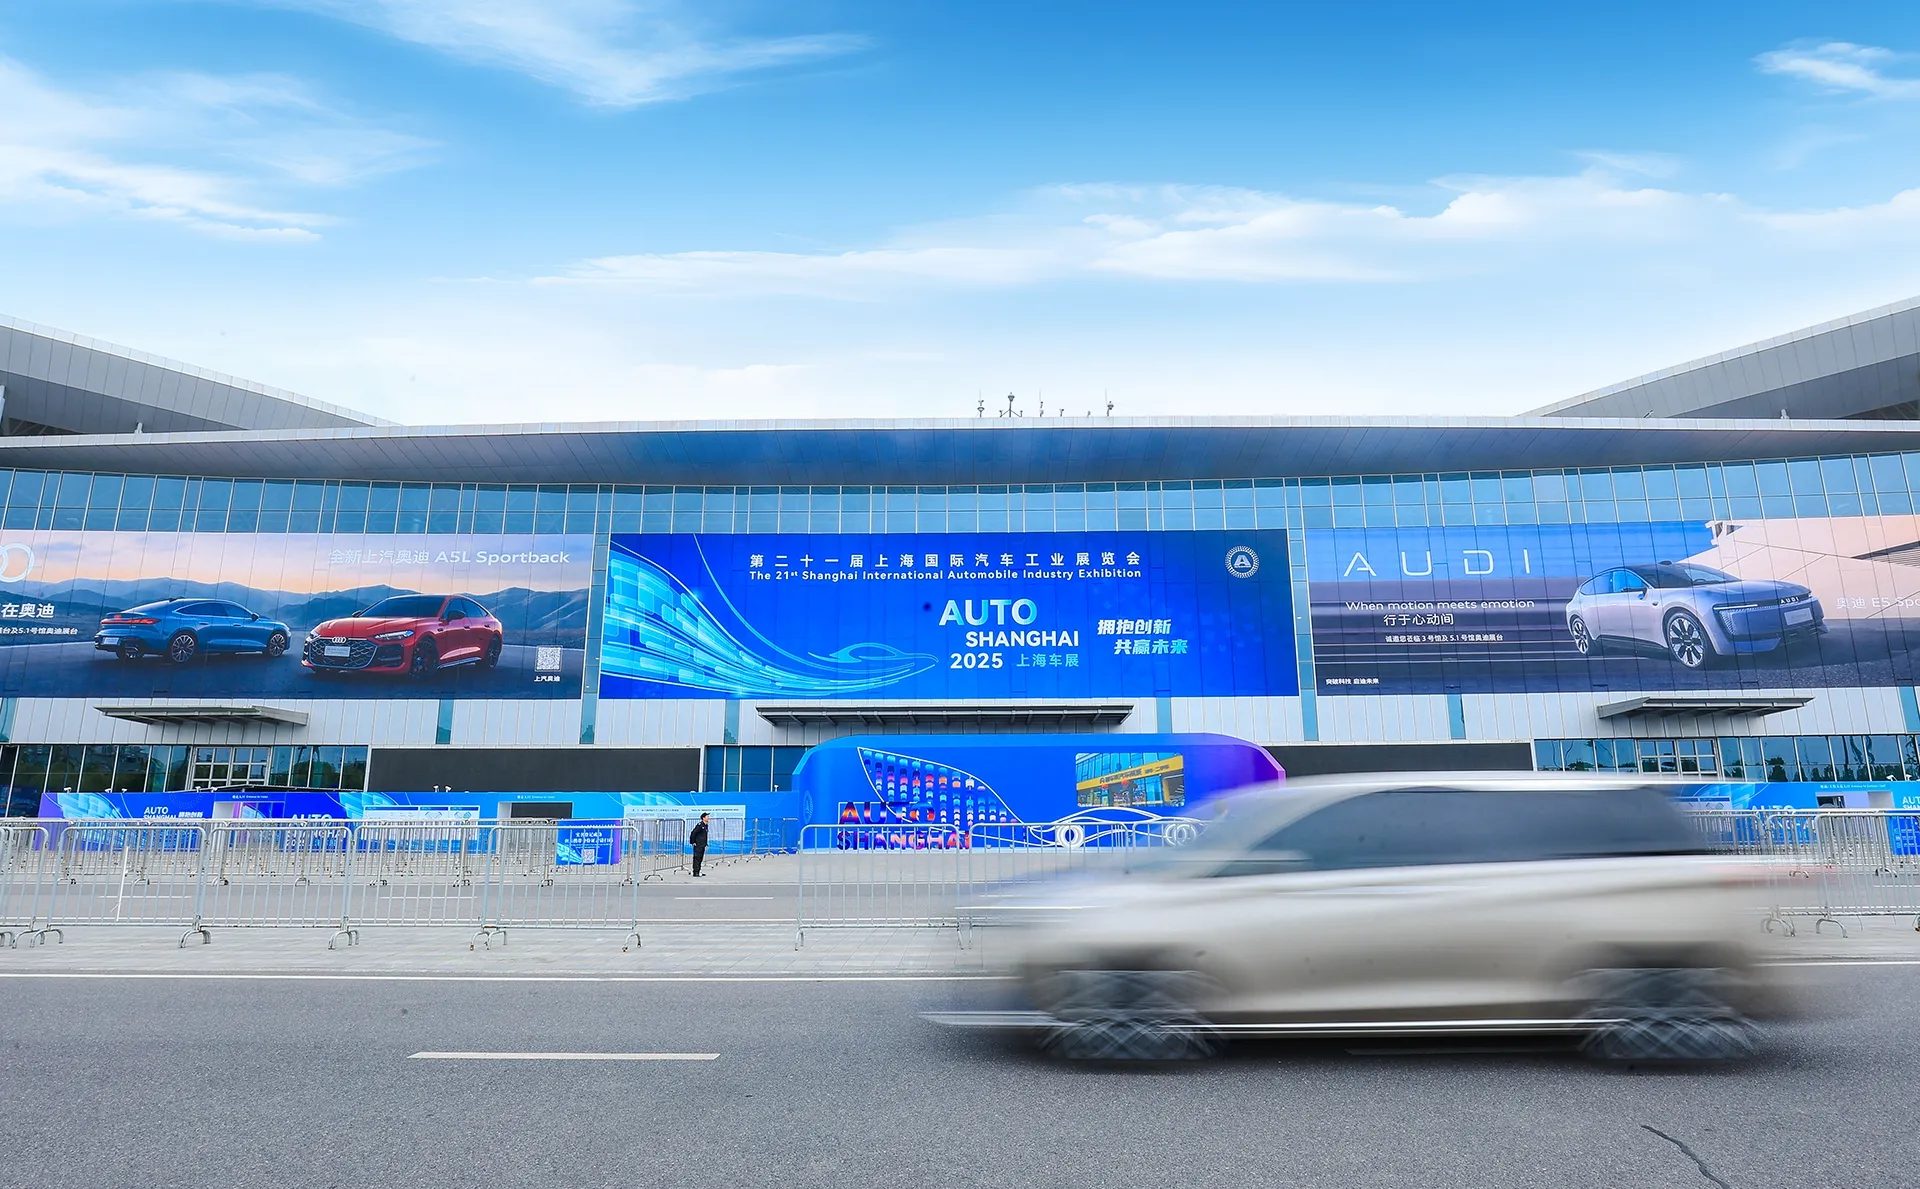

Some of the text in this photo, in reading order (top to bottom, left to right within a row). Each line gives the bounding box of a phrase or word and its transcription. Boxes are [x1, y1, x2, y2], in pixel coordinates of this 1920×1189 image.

[329, 549, 570, 566] 全新上汽奥迪 A5L Sportback
[750, 551, 1140, 568] 第二十一届上海国际汽车工业展览会
[1343, 548, 1531, 577] AUDI
[750, 568, 1141, 582] The 21st Shanghai International Automobile Industry Exhibition
[1346, 599, 1535, 611] When motion meets emotion
[1836, 597, 1866, 609] 奥迪
[1872, 597, 1890, 607] E5
[939, 599, 1037, 626] AUTO
[1383, 613, 1453, 626] 行于心动间
[0, 627, 78, 635] 台及5.1号馆奥迪展台
[1097, 619, 1171, 635] 拥抱创新
[965, 631, 1079, 647] SHANGHAI
[1114, 639, 1188, 655] 共赢未来
[950, 653, 1079, 669] 2025 上海车展
[144, 806, 169, 814] AUTO
[839, 801, 935, 825] AUTO
[837, 830, 970, 850] SHANGHAI
